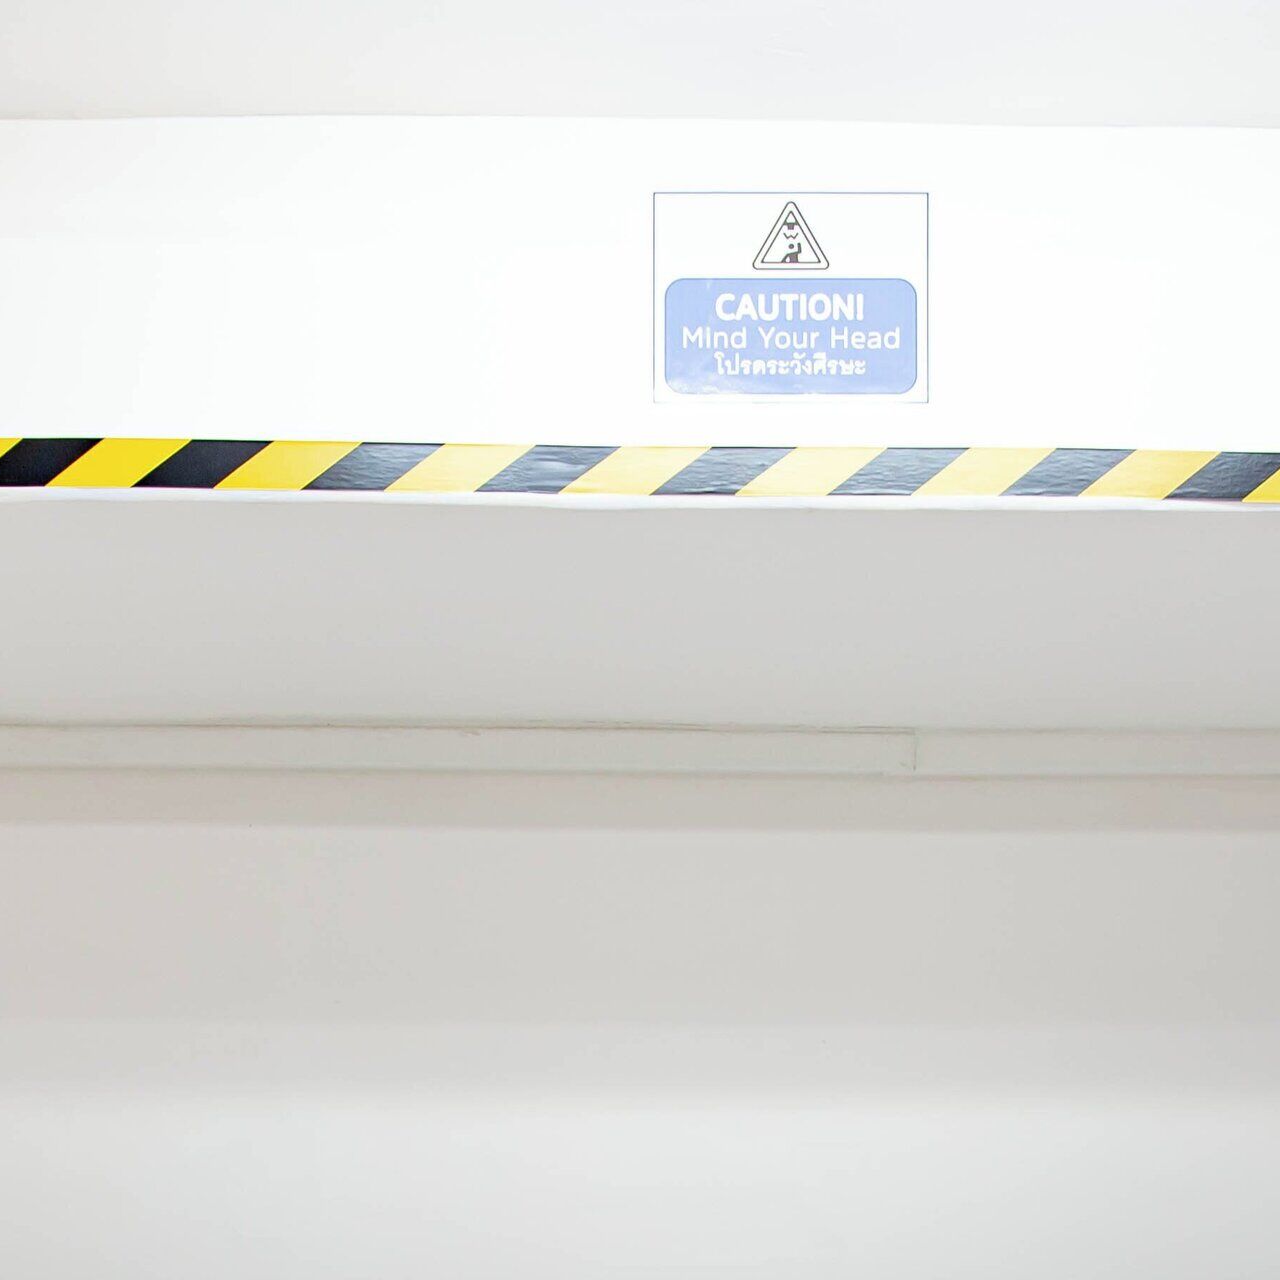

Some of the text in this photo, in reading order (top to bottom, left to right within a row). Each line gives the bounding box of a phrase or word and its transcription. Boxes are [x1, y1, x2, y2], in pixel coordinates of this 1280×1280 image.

[715, 293, 864, 321] CAUTION!
[682, 326, 901, 349] Mind Your Head
[714, 352, 866, 376] โปรดระวังศีรษะ
